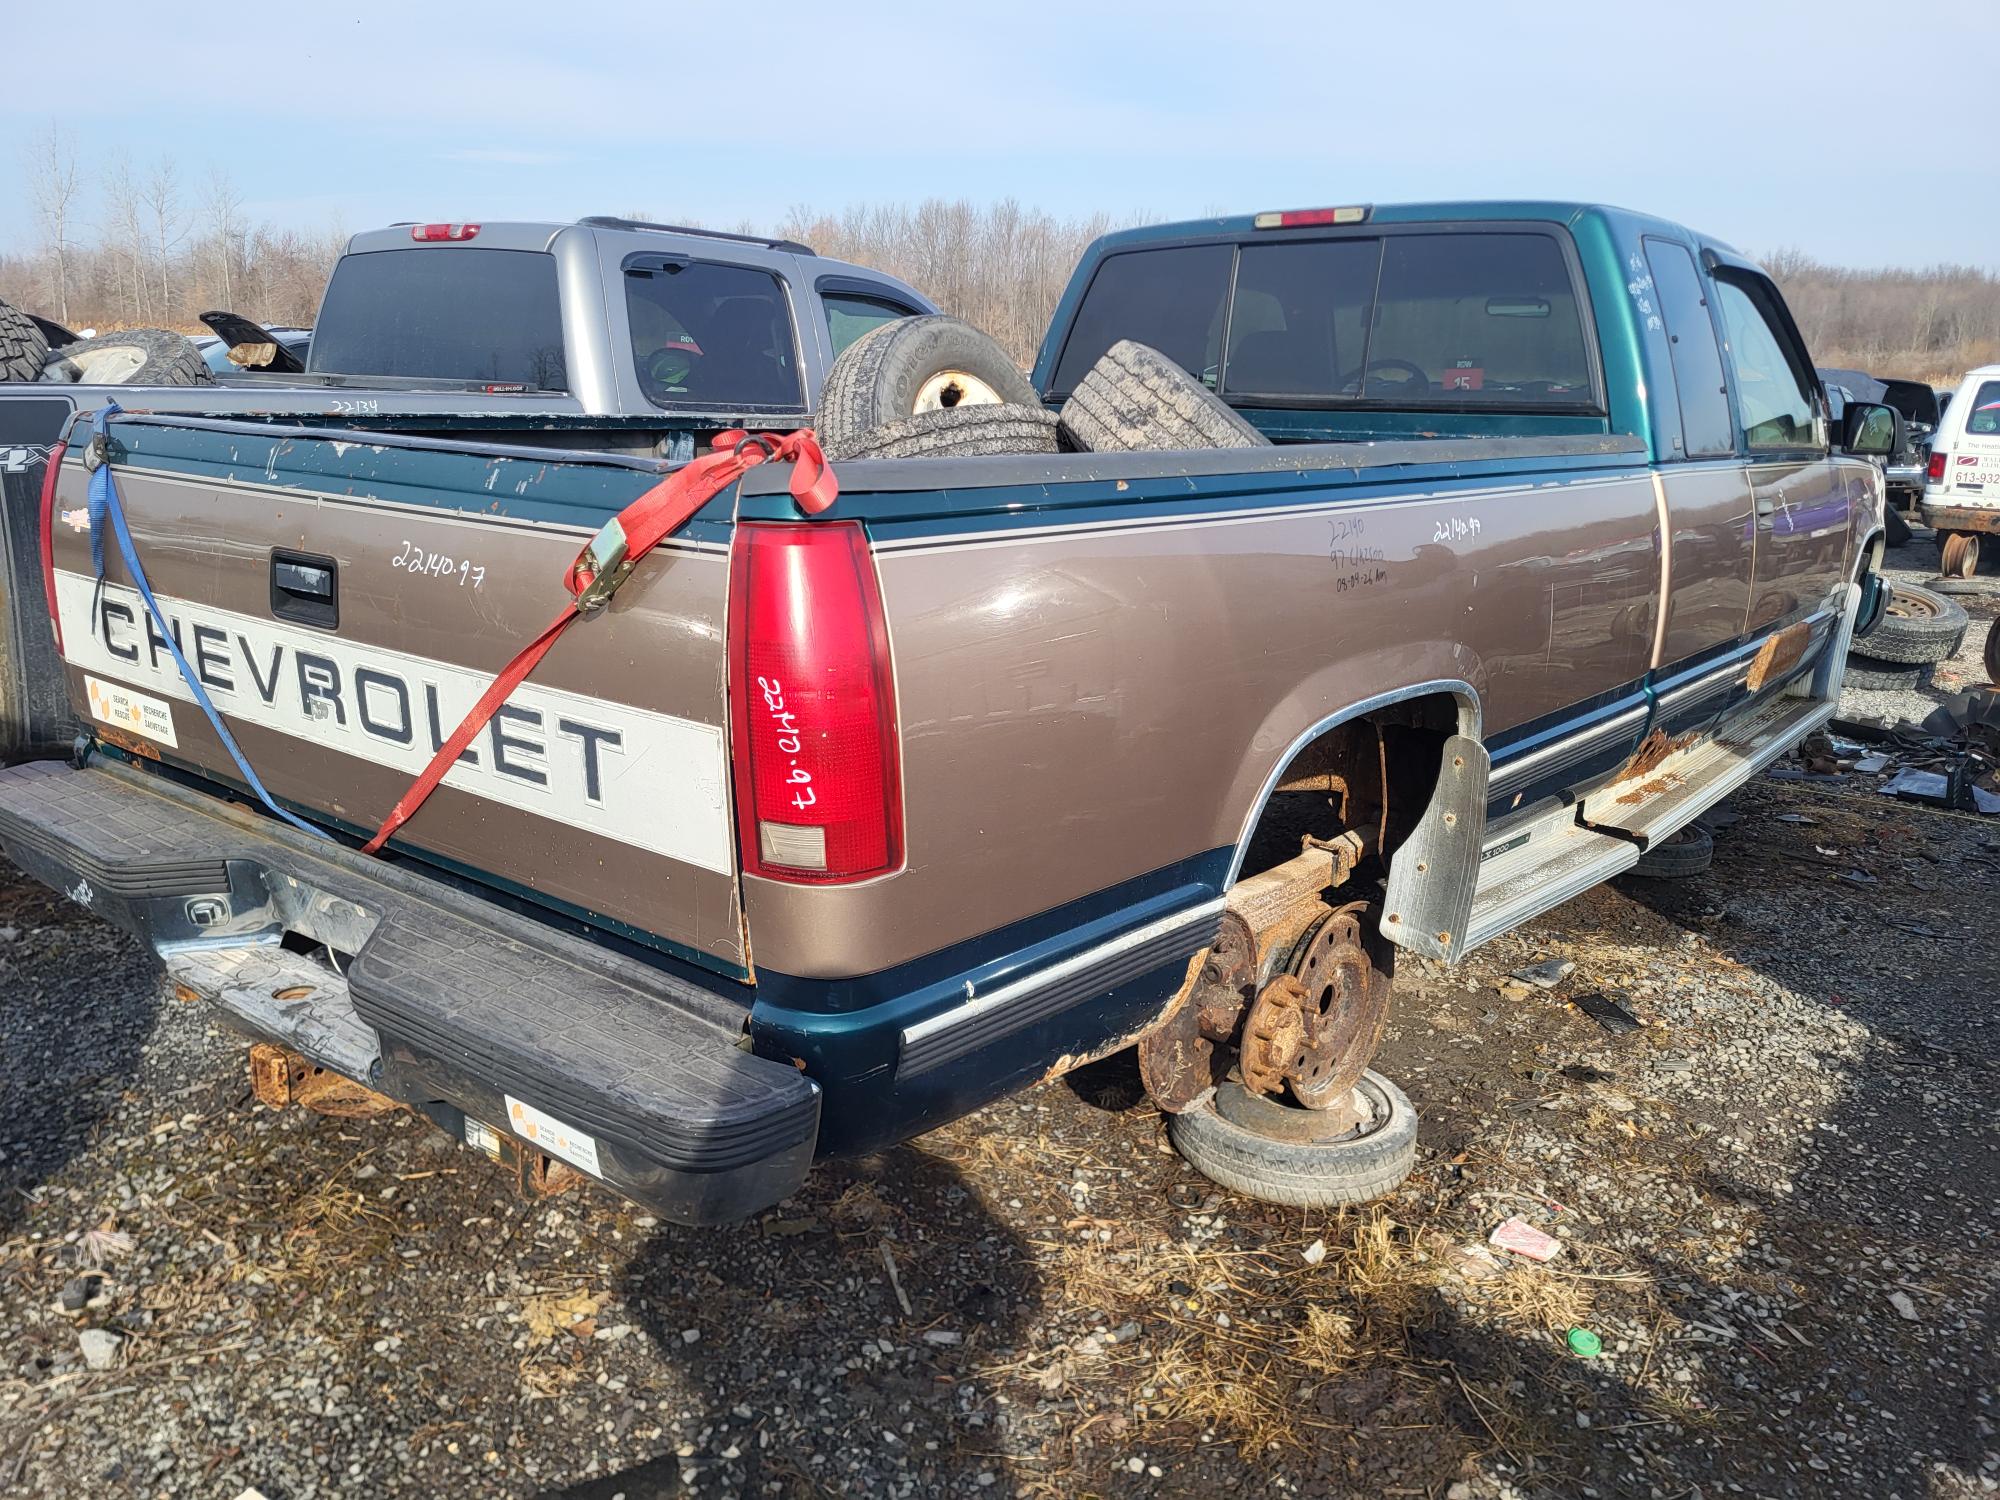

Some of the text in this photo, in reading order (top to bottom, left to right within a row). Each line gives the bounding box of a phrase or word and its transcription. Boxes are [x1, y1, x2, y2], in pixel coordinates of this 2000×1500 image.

[331, 400, 378, 412] 22134
[392, 540, 485, 588] 22140.97
[1330, 550, 1345, 570] 97
[100, 597, 624, 804] CHEVROLET
